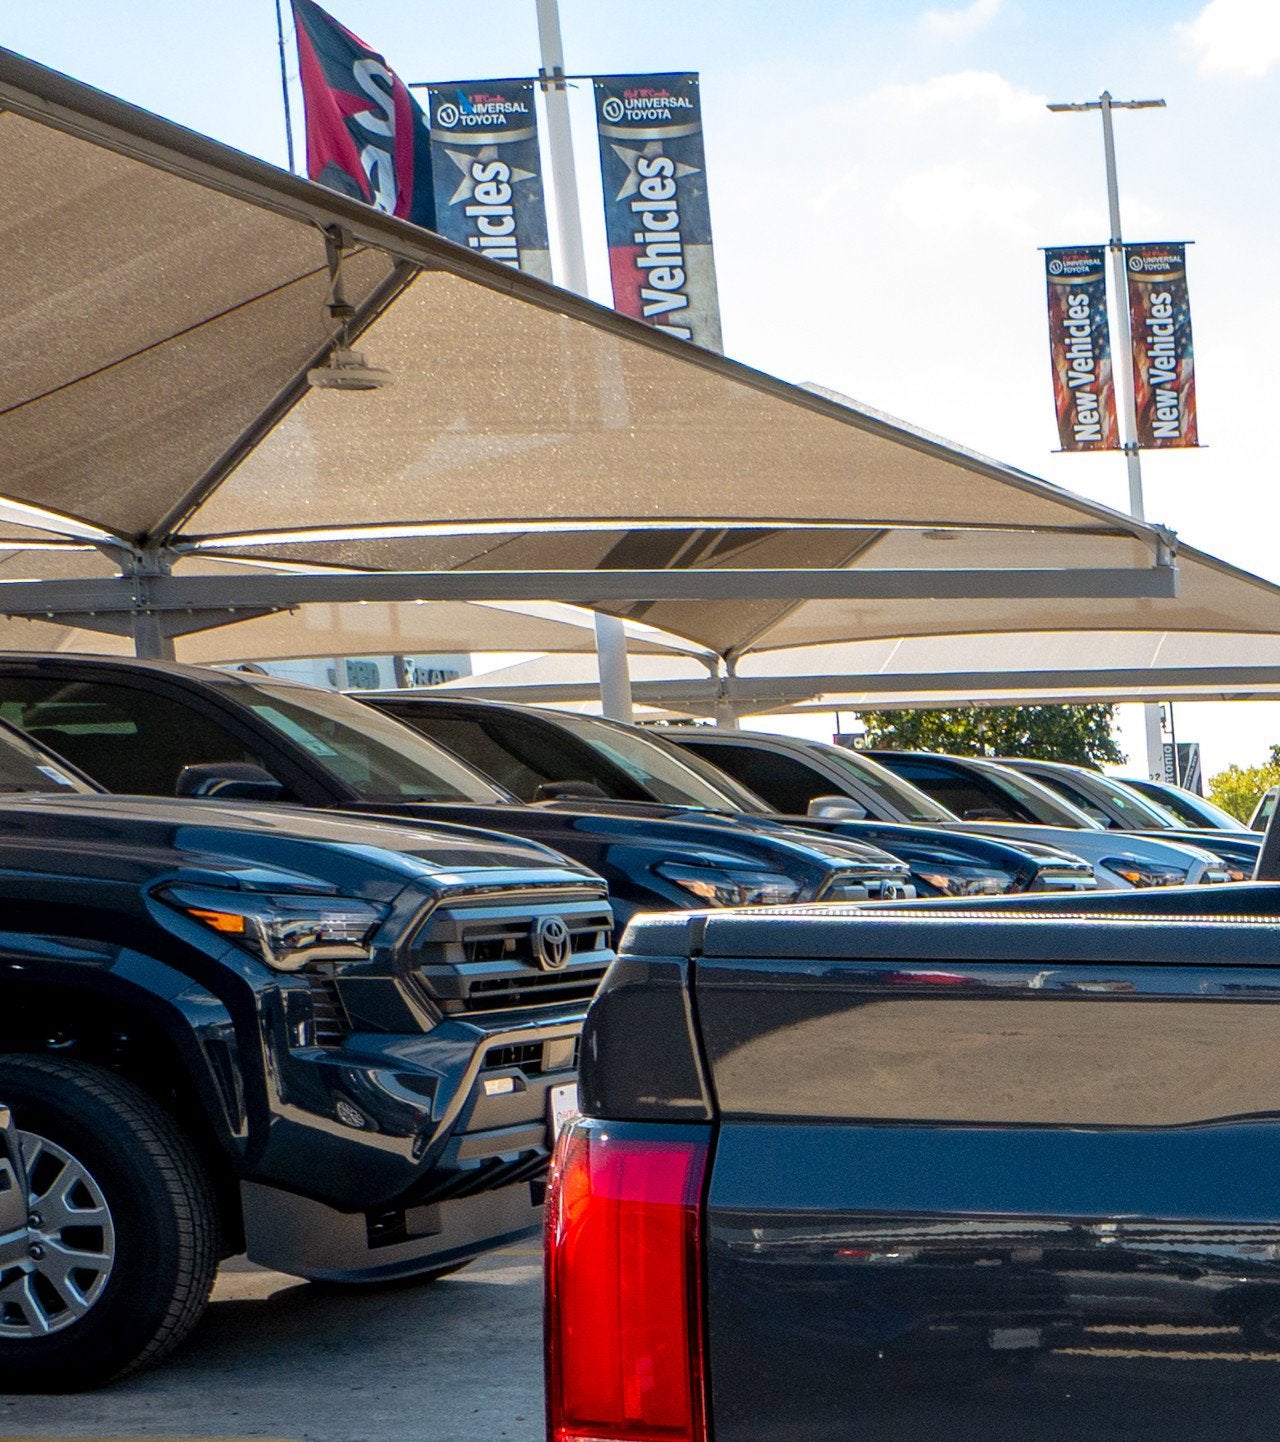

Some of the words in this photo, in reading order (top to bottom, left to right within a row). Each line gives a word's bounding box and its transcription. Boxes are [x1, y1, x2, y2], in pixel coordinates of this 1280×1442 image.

[625, 97, 694, 109] UNIVERSAL
[626, 109, 672, 121] TOYOTA
[460, 114, 507, 126] TOYOTA
[631, 156, 688, 318] Vehicles
[1062, 258, 1102, 268] UNIVERSAL
[1143, 256, 1182, 265] UNIVERSAL
[1063, 293, 1096, 389] Vehicles
[1146, 291, 1177, 386] Vehicles
[1074, 391, 1102, 442] New
[1152, 388, 1180, 438] New
